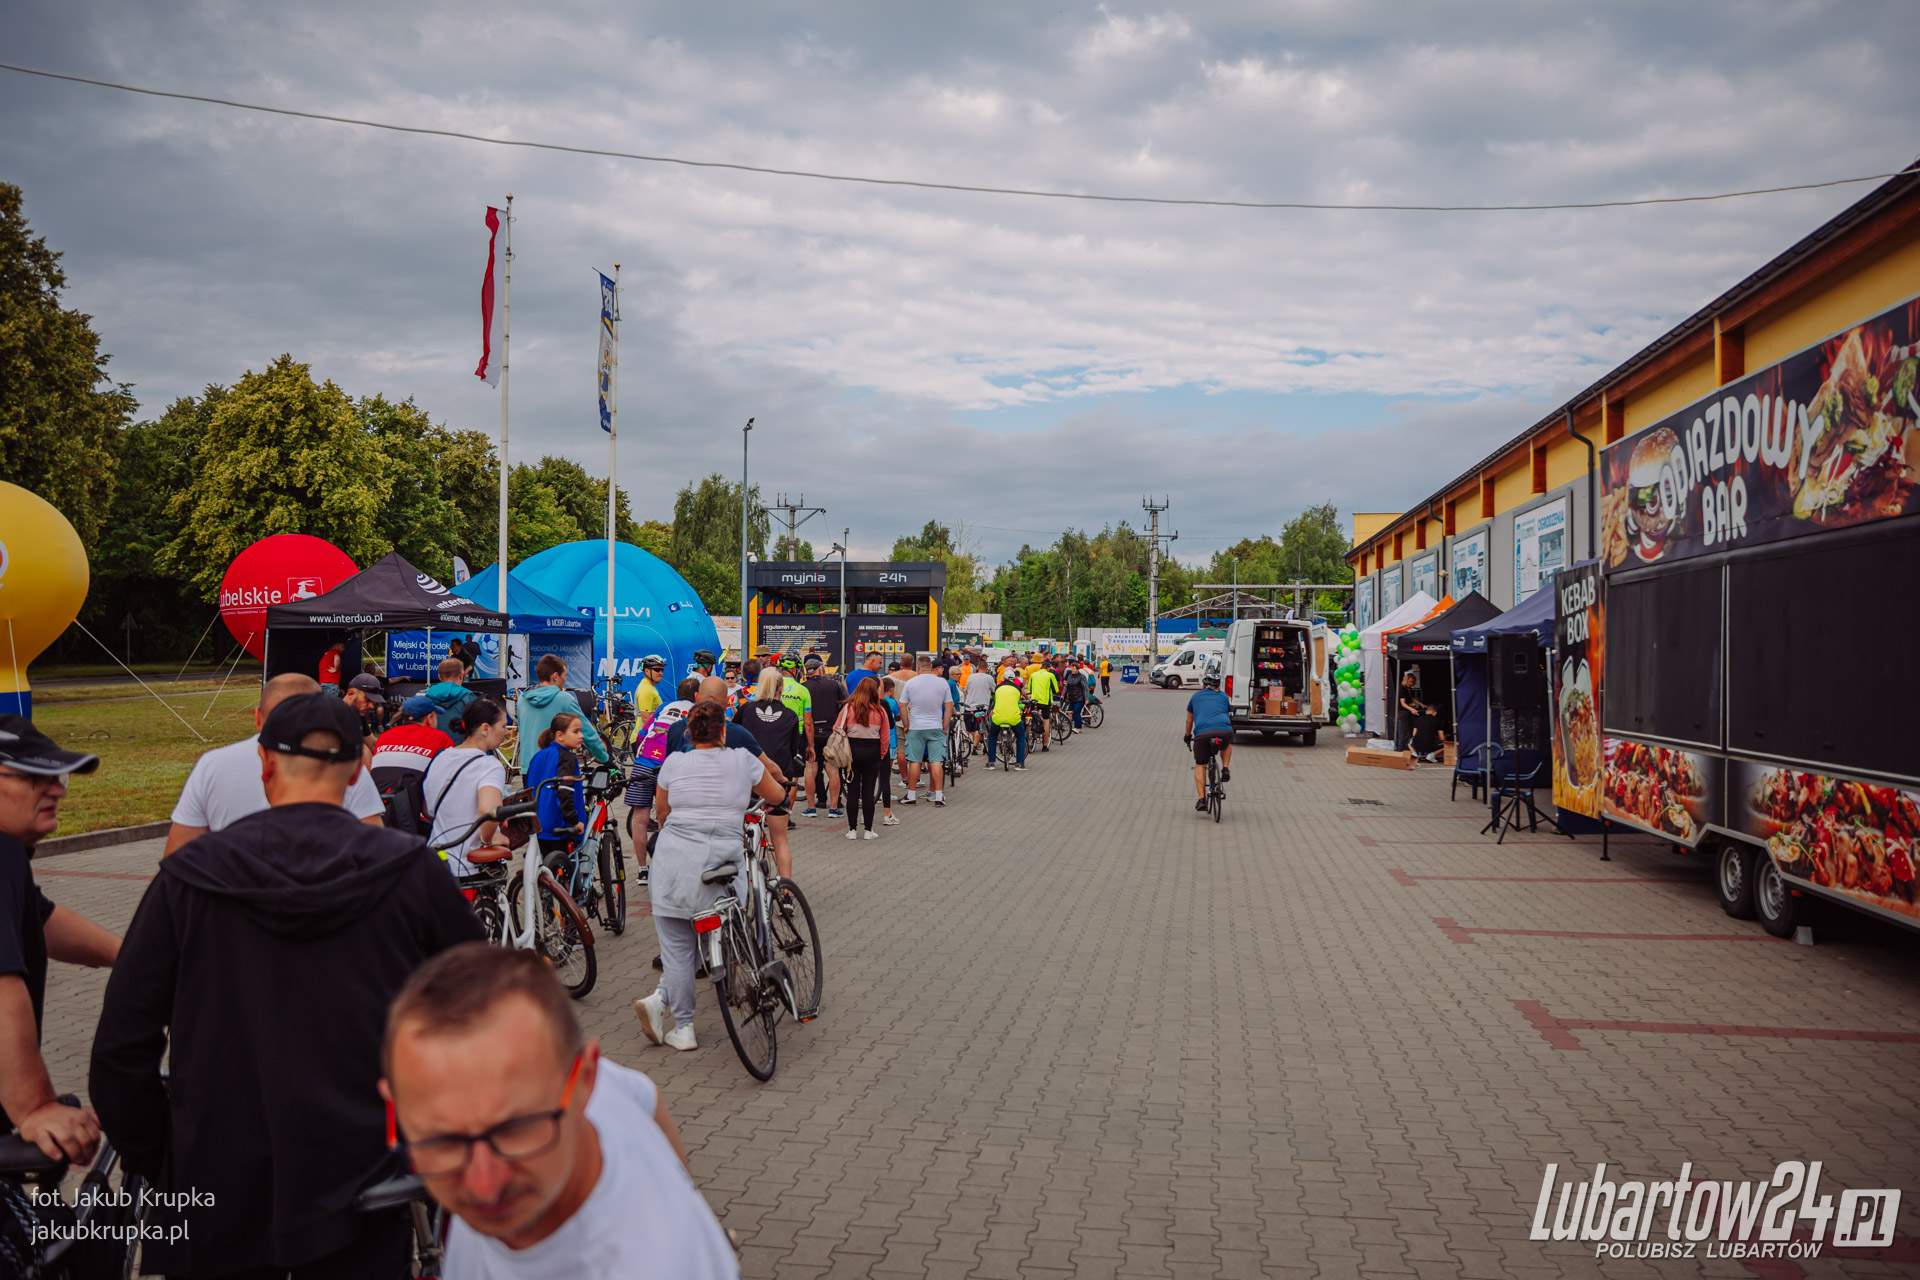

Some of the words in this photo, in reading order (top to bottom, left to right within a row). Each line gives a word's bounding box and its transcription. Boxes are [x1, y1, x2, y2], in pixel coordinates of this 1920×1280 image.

[1702, 475, 1748, 547] BAR
[781, 572, 826, 585] myjnia
[879, 572, 907, 583] 24h
[1561, 575, 1596, 617] KEBAB
[309, 612, 384, 624] www.interduo.pl
[1567, 609, 1590, 646] BOX
[393, 640, 418, 651] Miejski
[391, 650, 415, 661] Sportu
[421, 651, 450, 661] Rkreac
[397, 662, 404, 671] w
[405, 661, 439, 672] Lubarow
